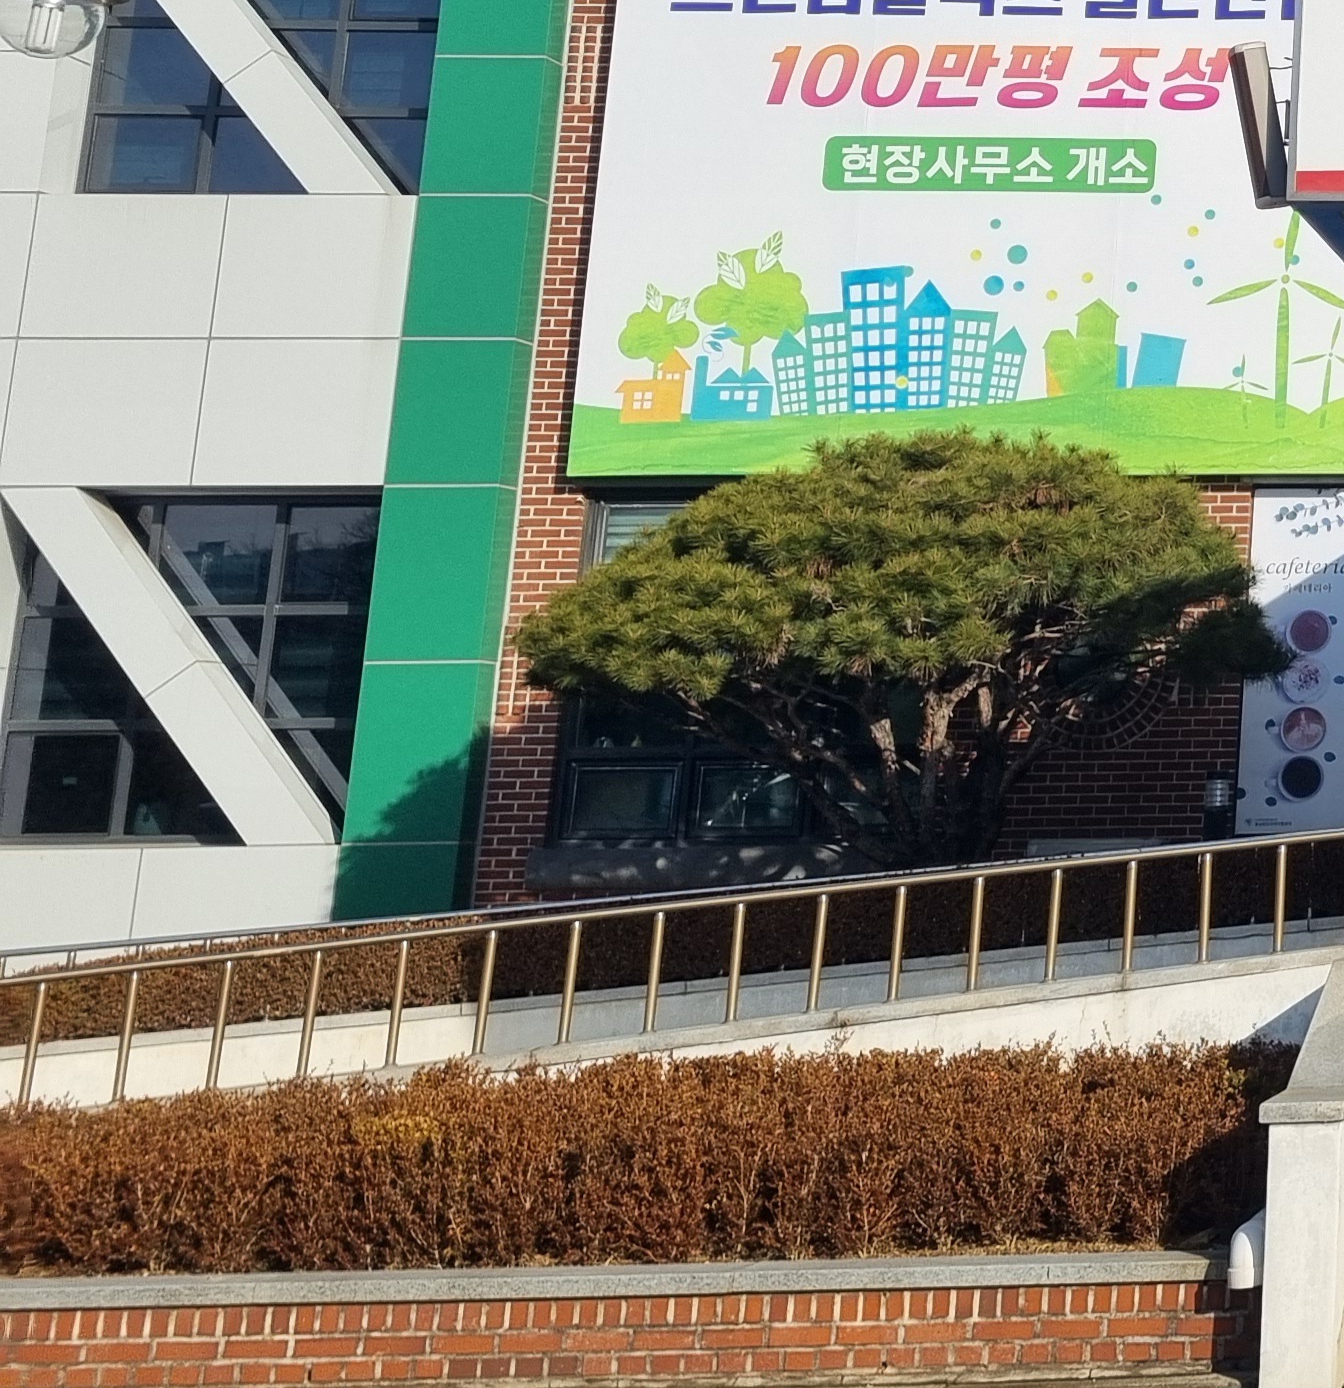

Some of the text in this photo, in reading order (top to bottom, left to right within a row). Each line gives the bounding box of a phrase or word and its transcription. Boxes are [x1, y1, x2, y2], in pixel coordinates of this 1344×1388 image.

[766, 44, 1231, 111] 100만평 조성
[840, 140, 1151, 186] 현장사무소 개소
